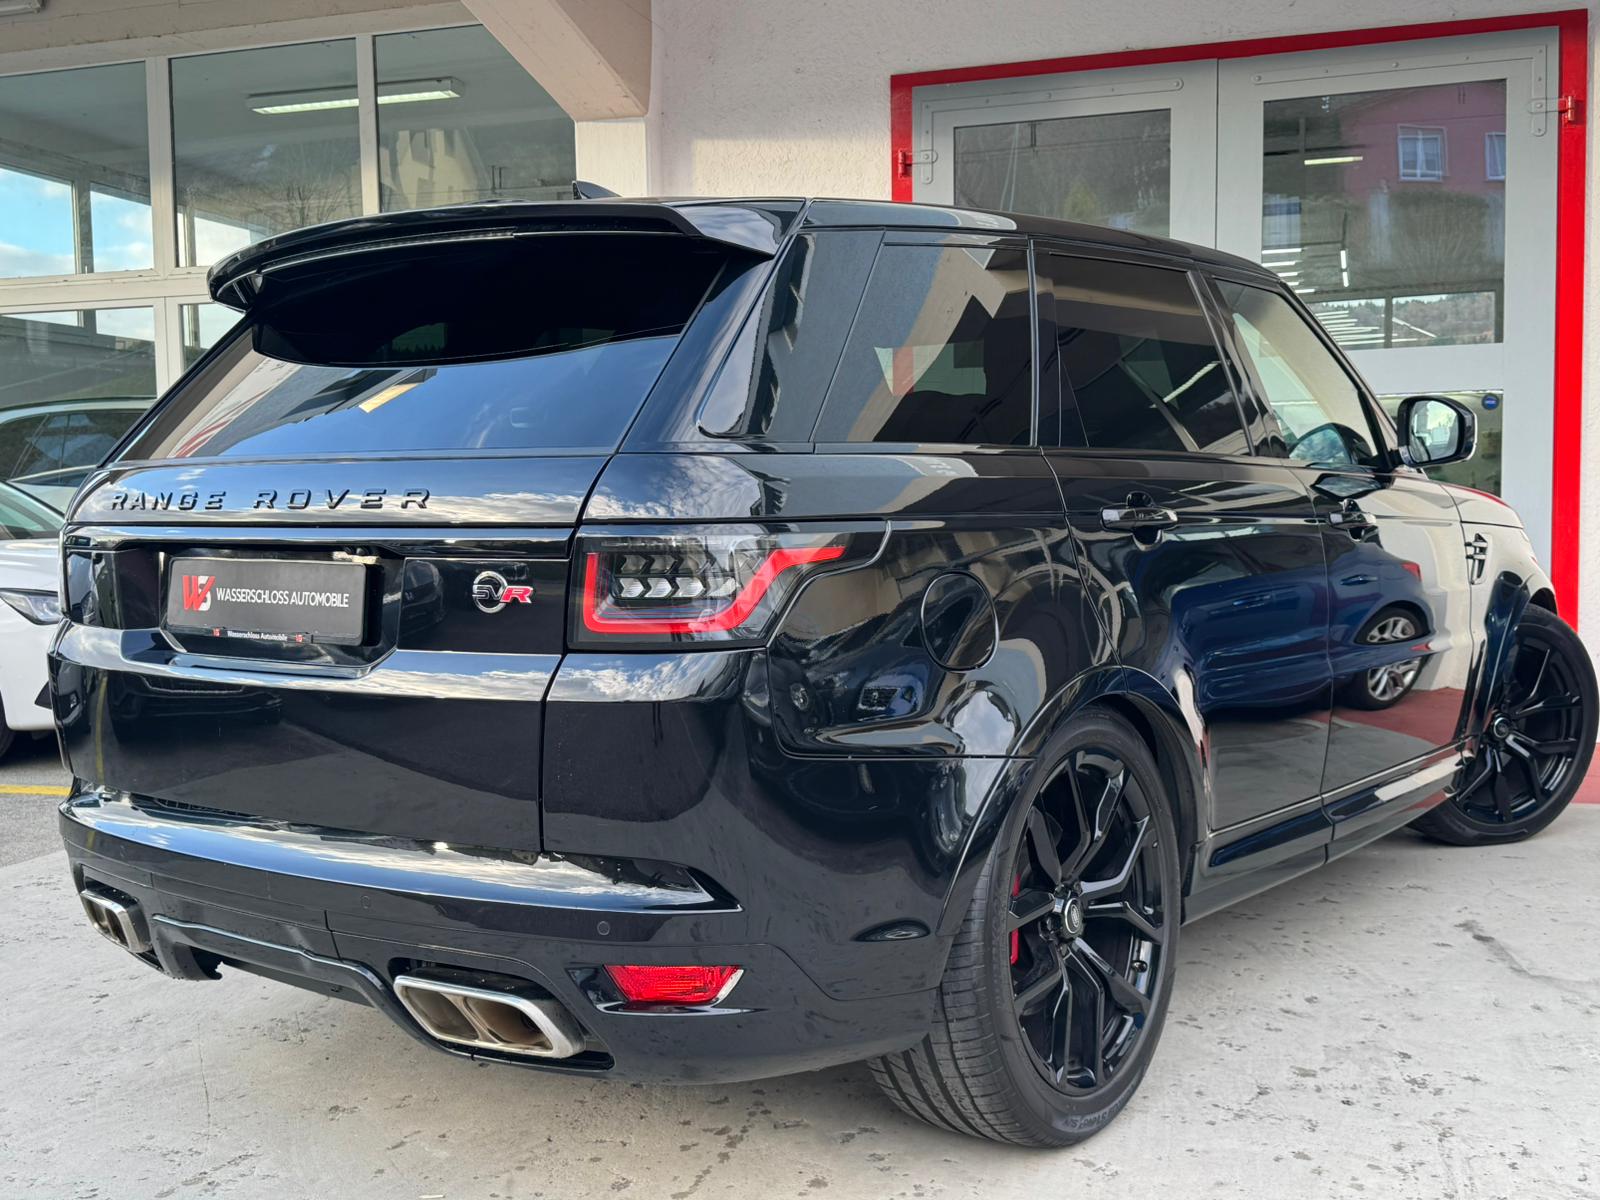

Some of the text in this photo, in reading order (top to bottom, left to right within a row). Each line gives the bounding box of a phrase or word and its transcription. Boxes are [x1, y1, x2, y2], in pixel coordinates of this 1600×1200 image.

[111, 489, 430, 511] RANGE ROVER
[216, 588, 349, 607] WASSERSCHLOSS AUTOMOBILE
